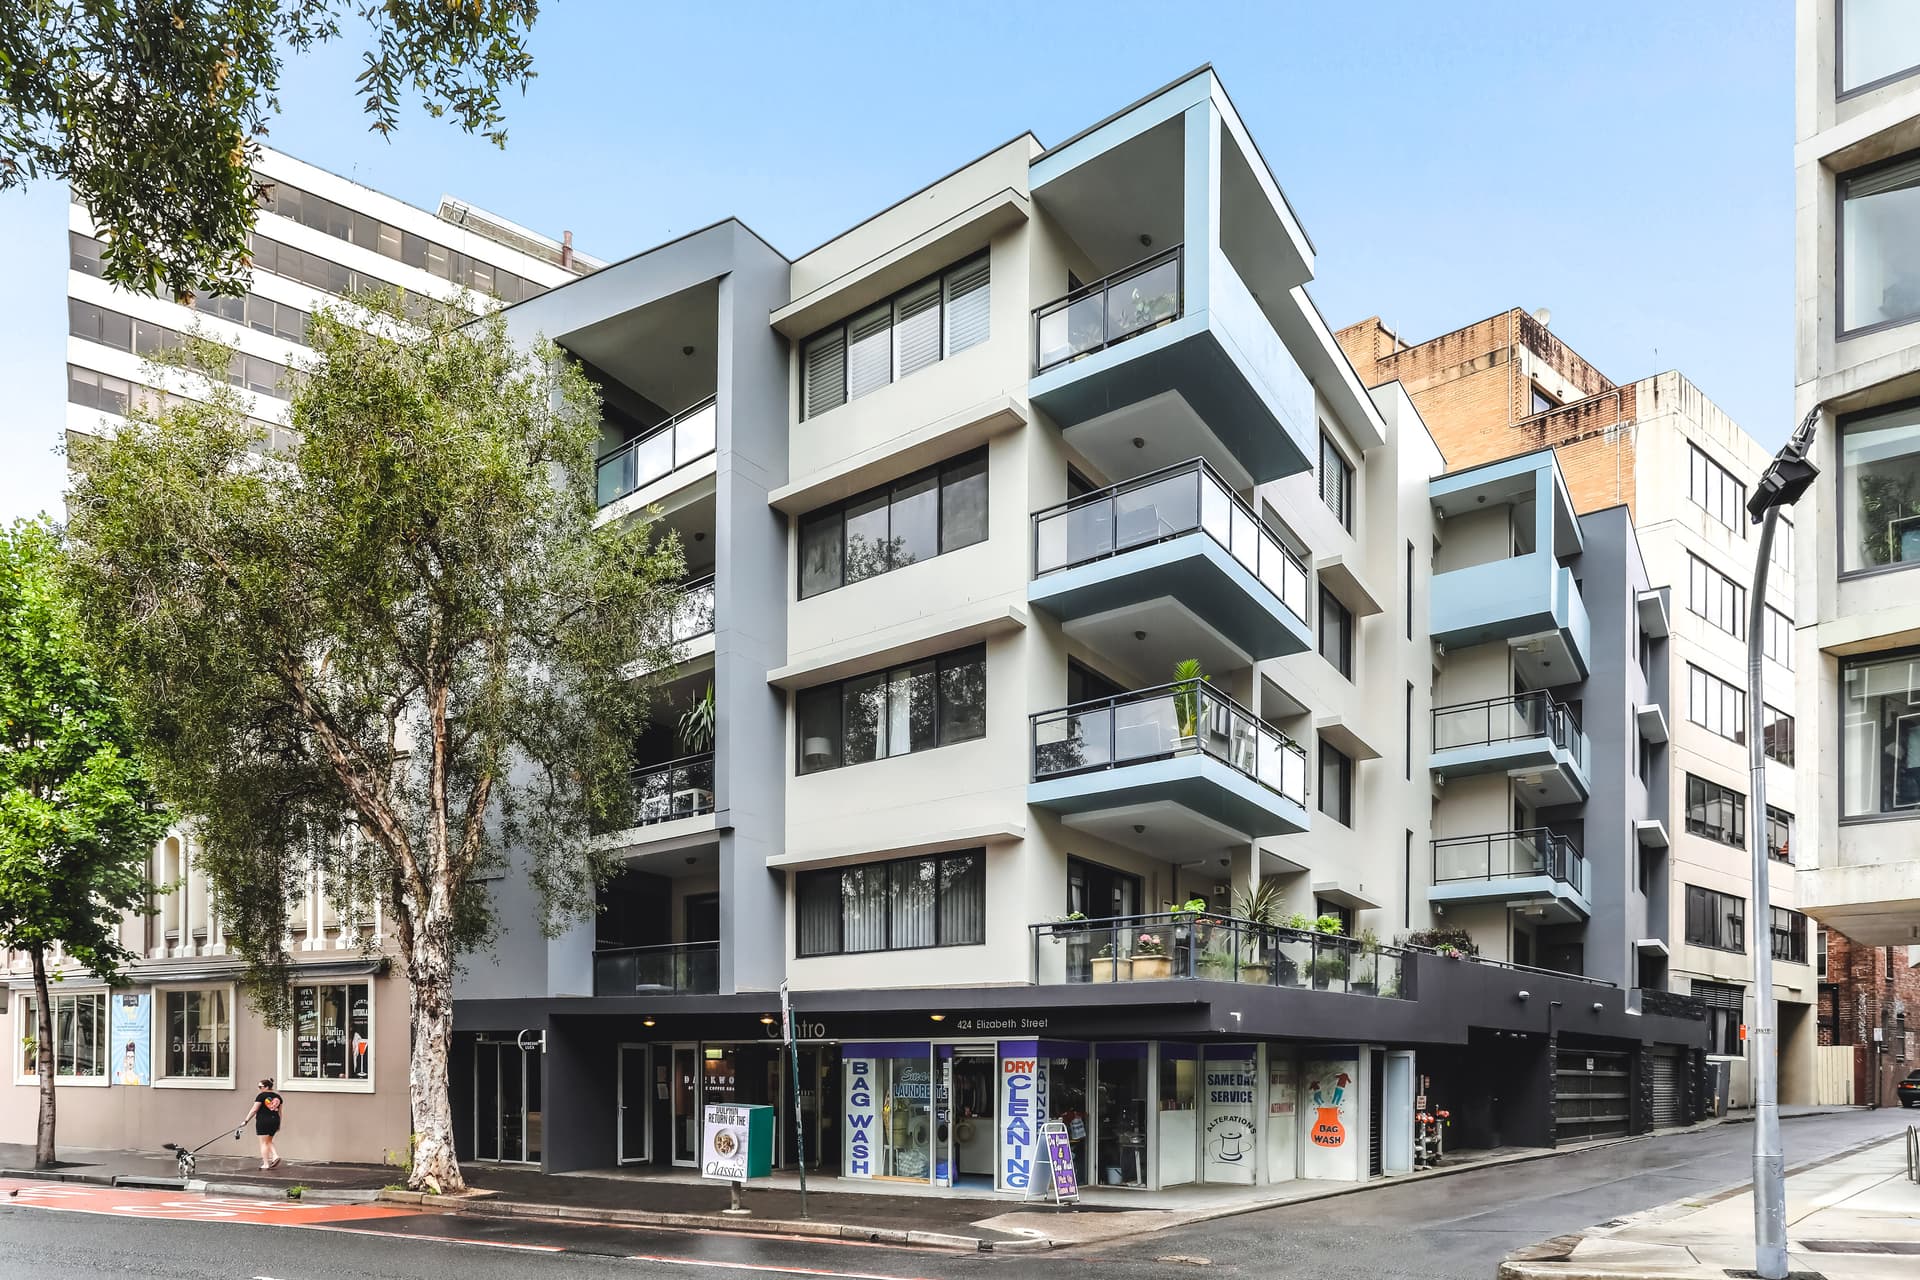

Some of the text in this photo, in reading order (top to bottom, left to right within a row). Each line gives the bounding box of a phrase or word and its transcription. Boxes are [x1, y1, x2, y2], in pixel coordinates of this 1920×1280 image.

[766, 1018, 826, 1039] Cntro
[957, 1018, 1048, 1030] 424 Elizabeth Street
[1004, 1060, 1036, 1074] DRY
[1207, 1073, 1236, 1087] SAME
[1236, 1073, 1257, 1087] DAY
[894, 1083, 949, 1099] LAUNDRETE
[1210, 1091, 1253, 1104] SERVICE
[708, 1113, 746, 1126] RETURN OF THE
[847, 1062, 874, 1175] BAG WASH
[1206, 1115, 1257, 1135] ALTERATIONS
[1006, 1075, 1032, 1188] CLEANING
[1319, 1125, 1338, 1133] BAG
[1314, 1135, 1341, 1144] WASH
[706, 1161, 746, 1179] Classics
